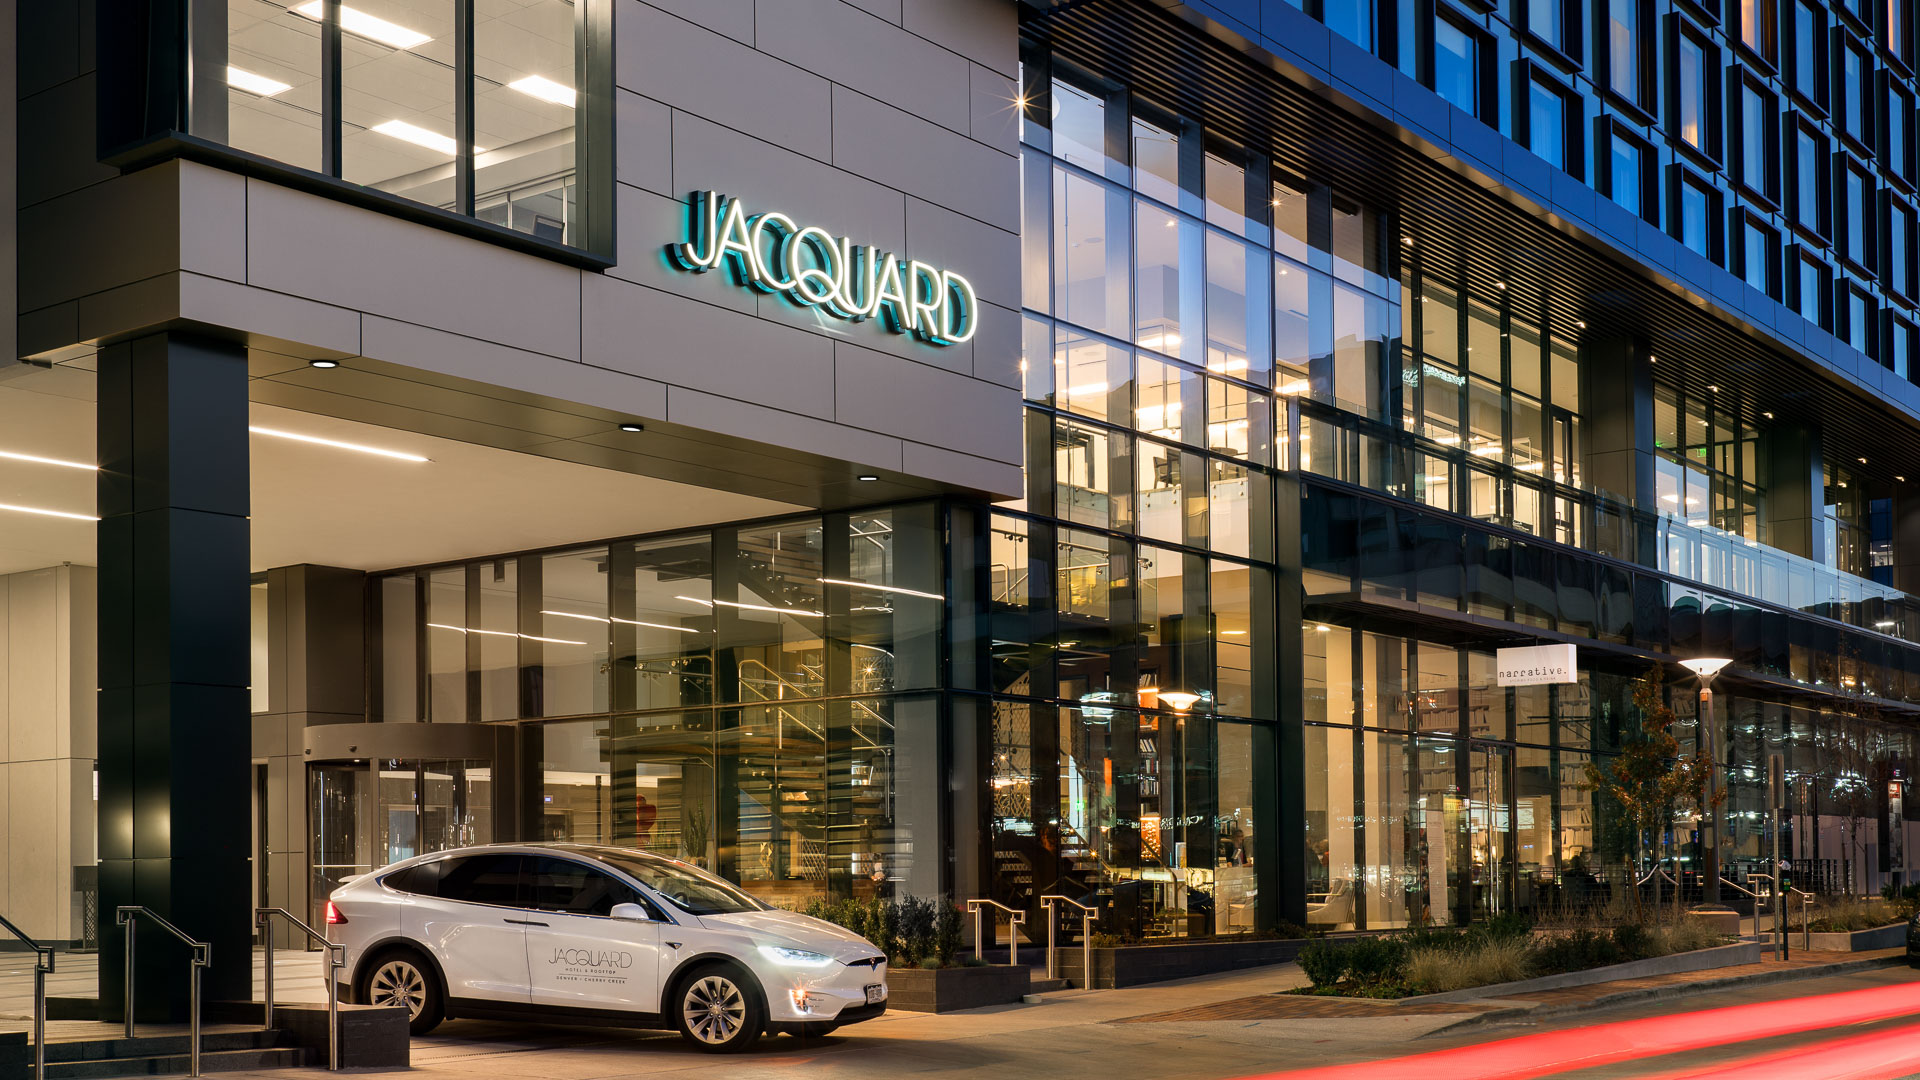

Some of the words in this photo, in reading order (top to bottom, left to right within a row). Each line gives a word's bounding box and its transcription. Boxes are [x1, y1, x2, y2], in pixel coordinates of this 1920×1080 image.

[674, 189, 979, 345] JACQUARD
[1499, 666, 1567, 678] narrative.
[548, 947, 633, 968] JACQUARD
